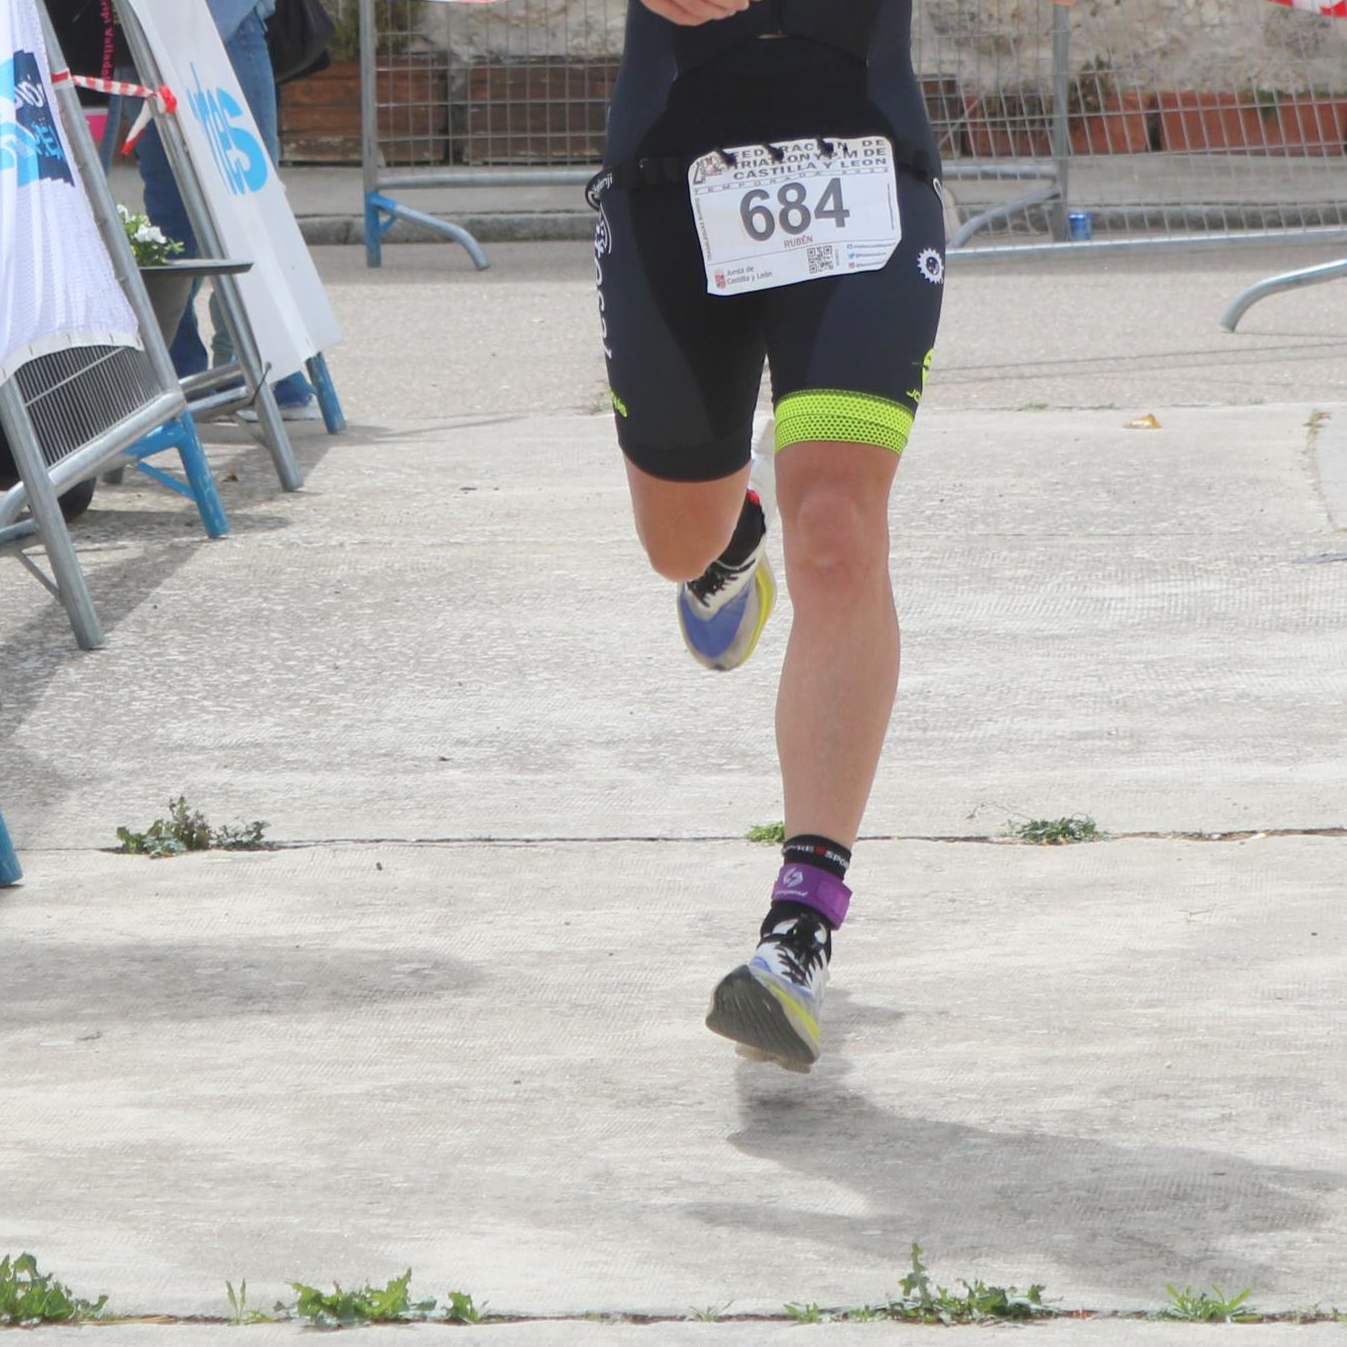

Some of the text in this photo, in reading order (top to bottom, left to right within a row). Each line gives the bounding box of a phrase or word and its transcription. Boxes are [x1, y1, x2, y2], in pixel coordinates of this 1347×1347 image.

[863, 148, 886, 157] DE
[733, 158, 886, 180] CASTILLA Y LEON
[739, 177, 850, 242] 684
[783, 235, 814, 249] RUBÉN
[726, 274, 750, 285] Castilla
